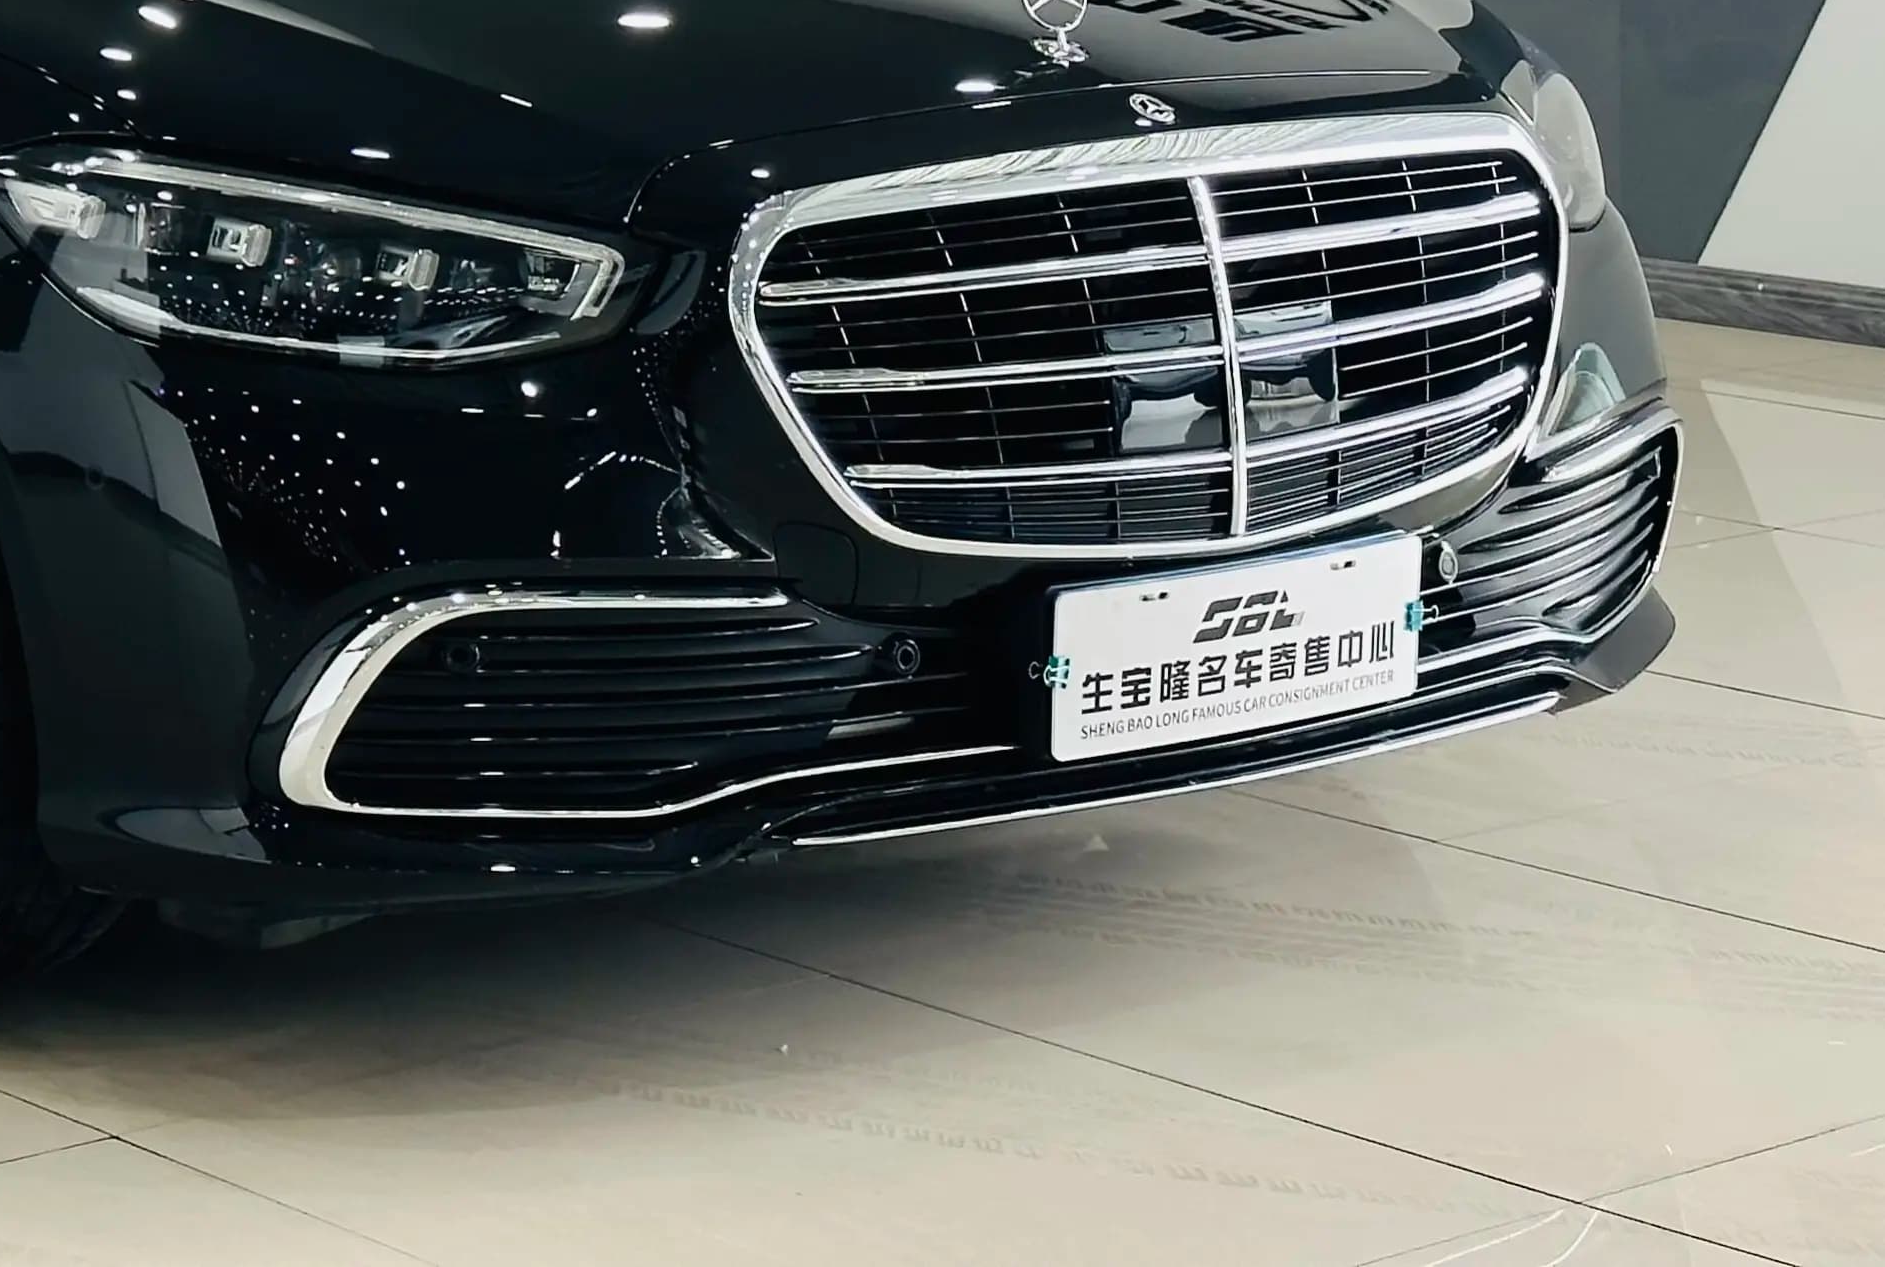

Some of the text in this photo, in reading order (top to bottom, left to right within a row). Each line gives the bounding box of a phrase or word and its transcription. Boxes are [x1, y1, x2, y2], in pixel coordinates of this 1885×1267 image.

[1080, 669, 1394, 740] SHENG BAO LONG FAMOUS CAR CONSIGNMENT CENTER
[1081, 620, 1396, 716] 生宝隆名车寄售中心
